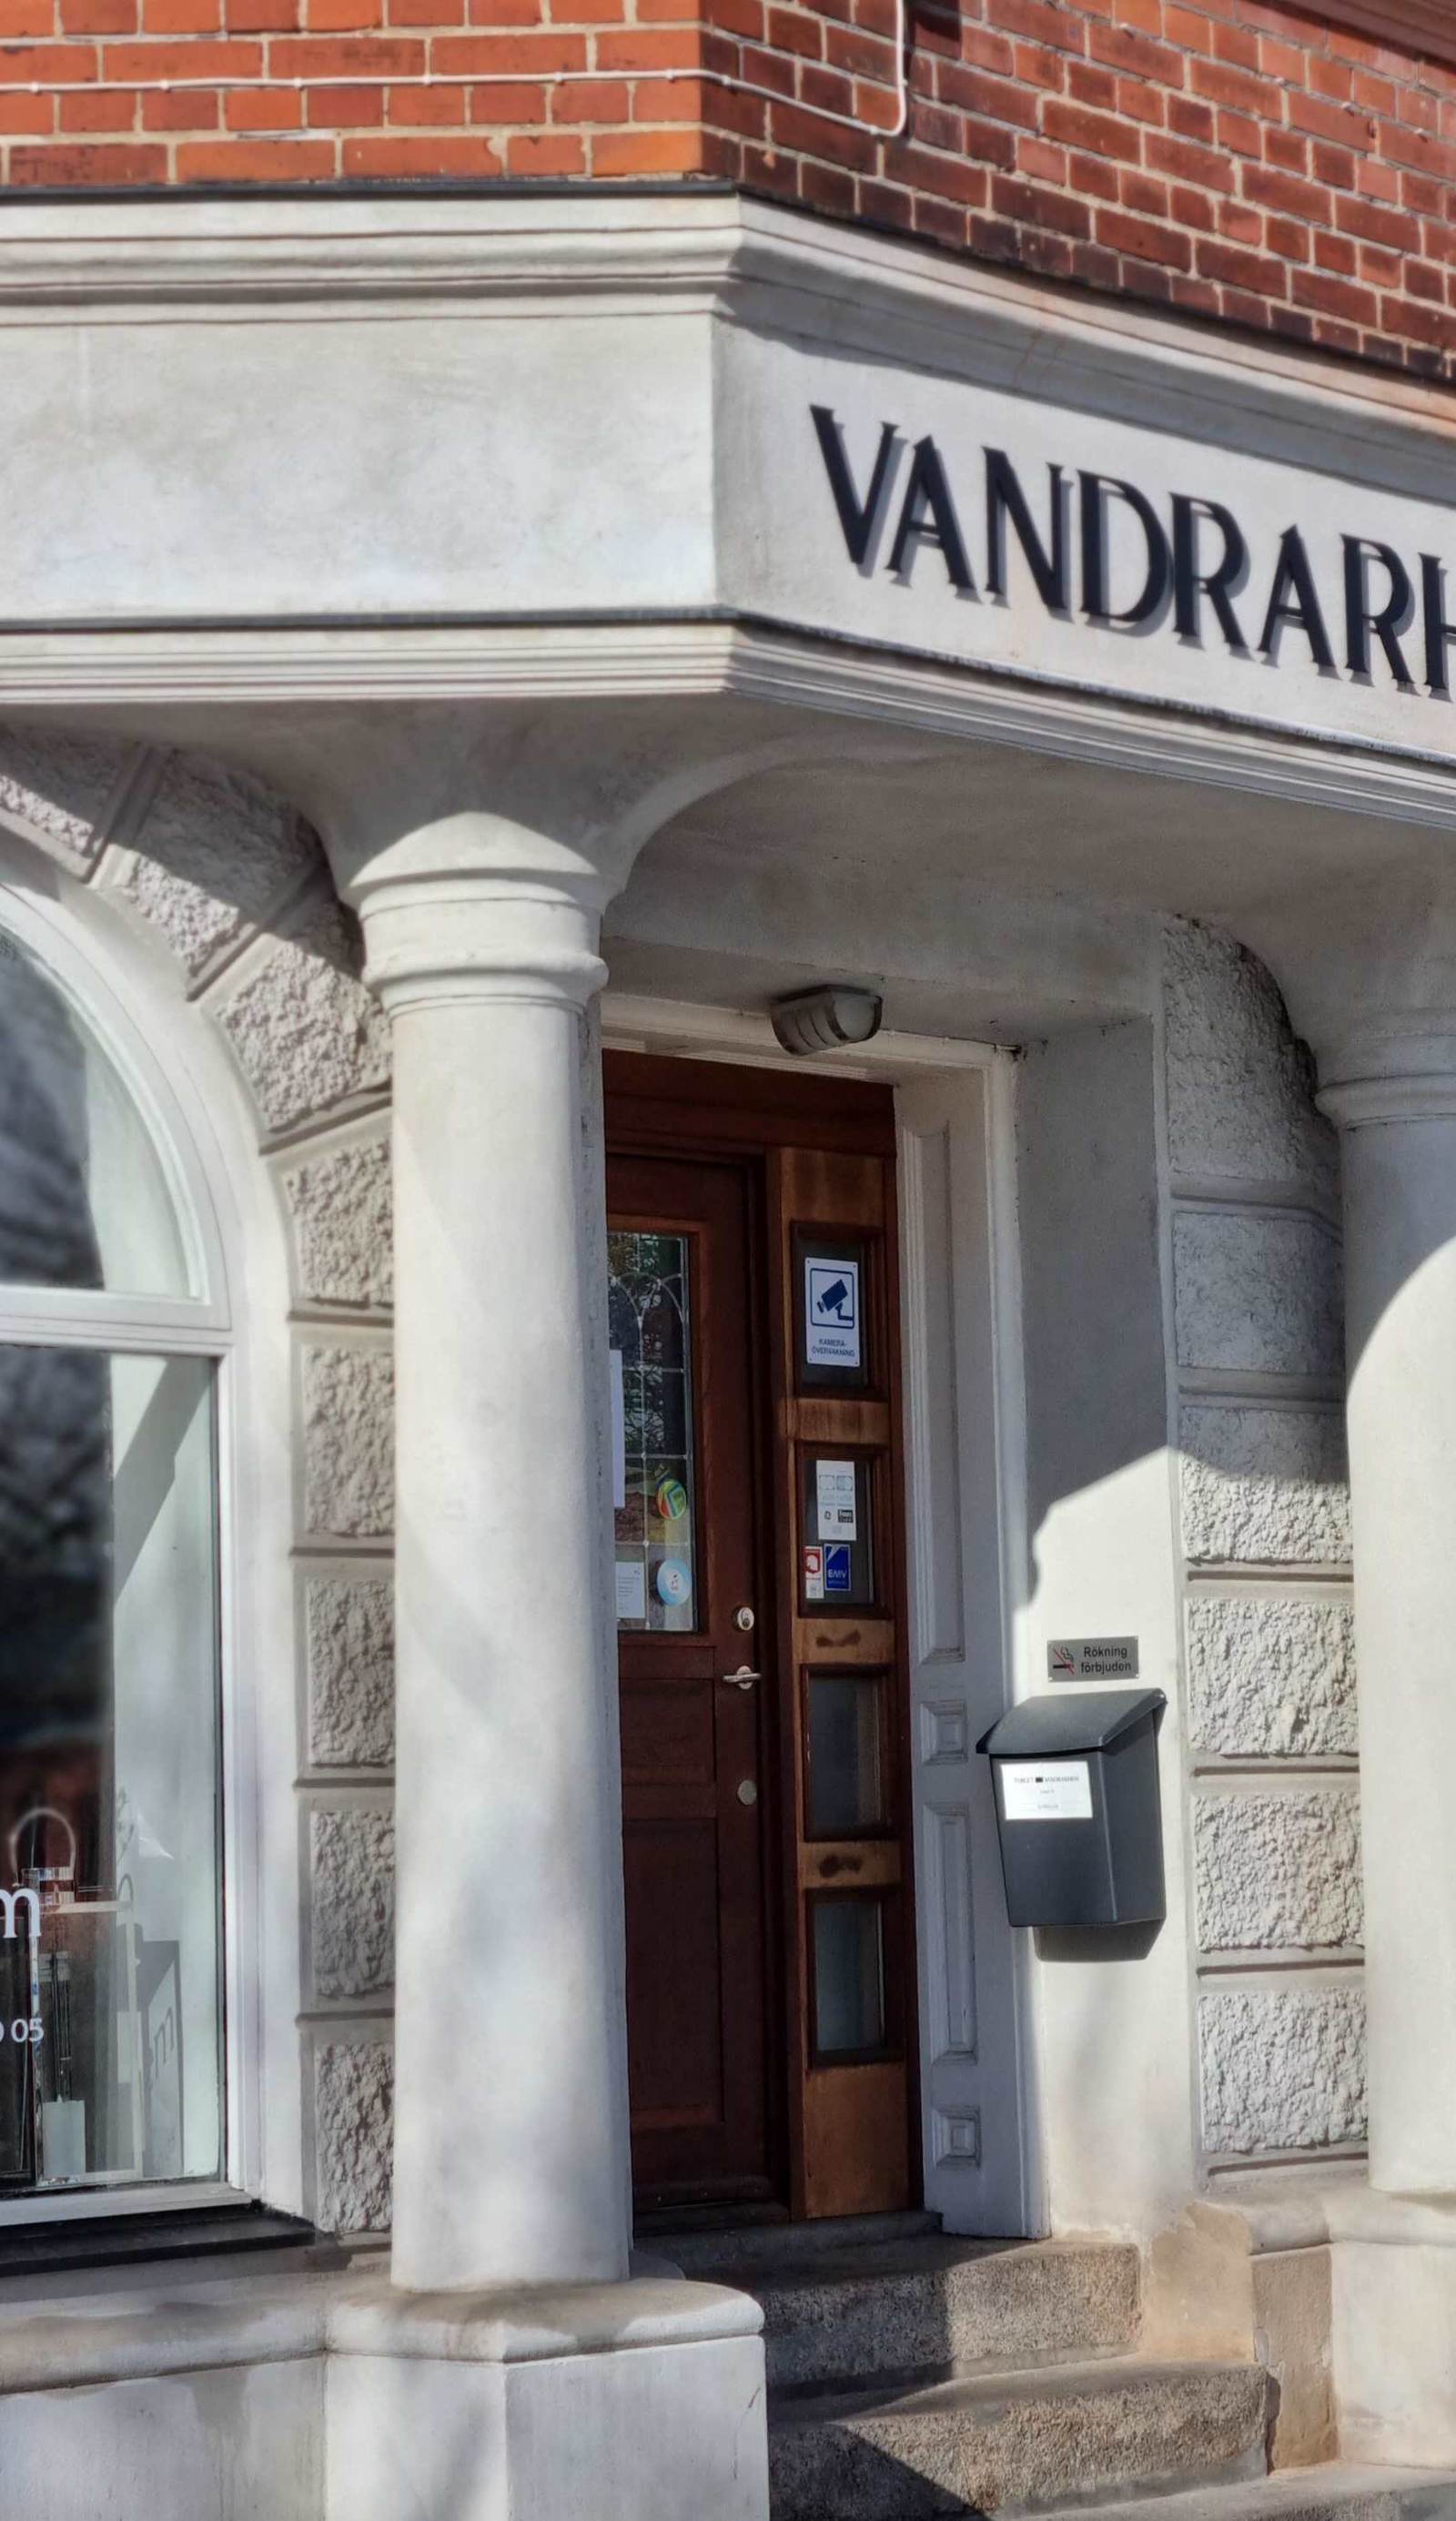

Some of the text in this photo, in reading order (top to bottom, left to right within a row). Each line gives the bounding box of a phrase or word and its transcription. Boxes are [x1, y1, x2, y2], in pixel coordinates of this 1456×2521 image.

[827, 1568, 847, 1579] EMV
[1084, 1645, 1128, 1659] Rökning
[1080, 1661, 1132, 1676] förbjuden
